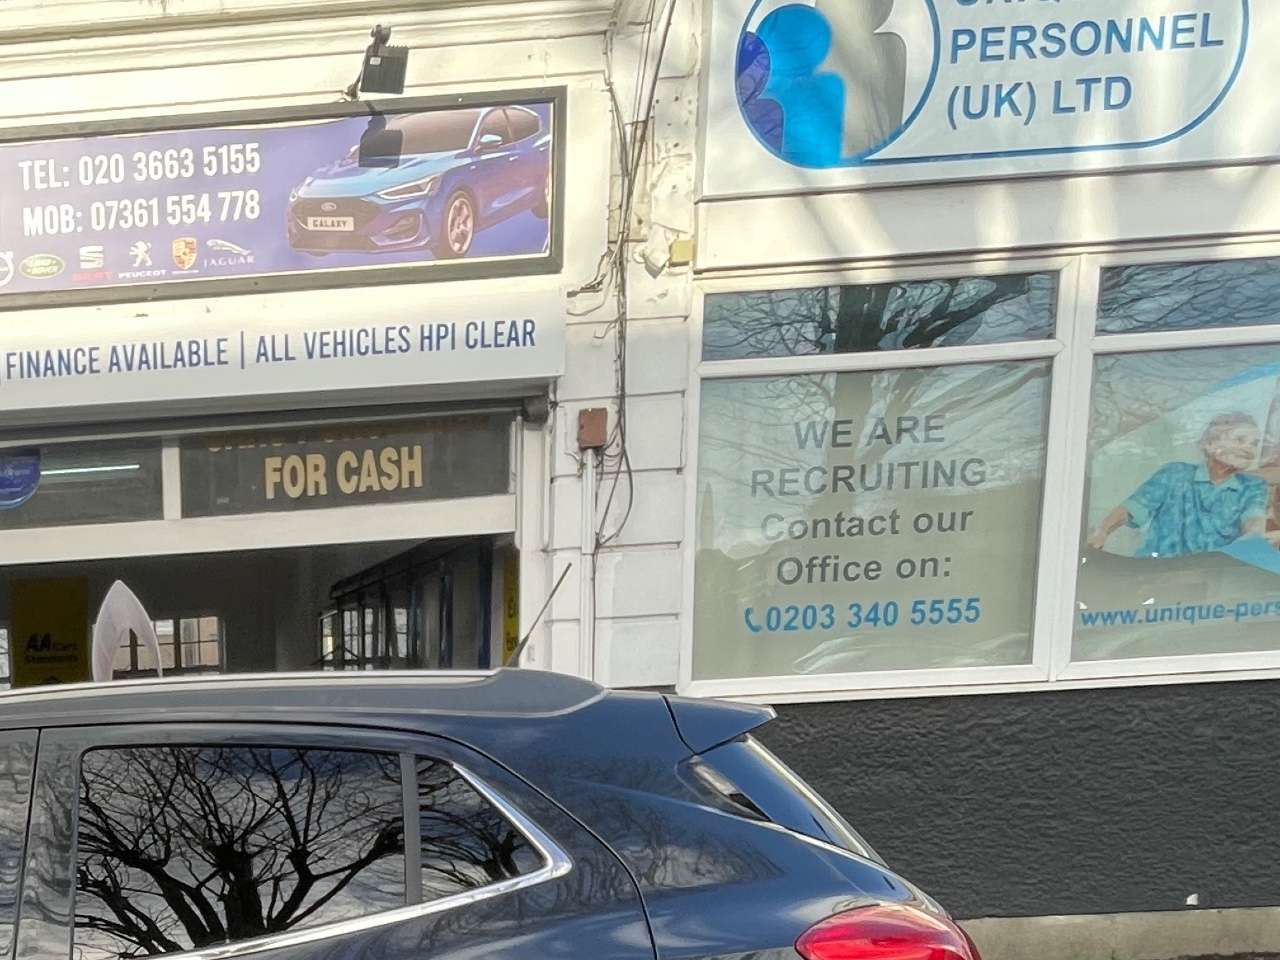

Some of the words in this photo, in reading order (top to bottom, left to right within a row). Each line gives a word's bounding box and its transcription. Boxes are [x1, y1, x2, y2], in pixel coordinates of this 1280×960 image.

[950, 13, 1224, 65] PERSONNEL
[947, 80, 1036, 130] (UK)
[1052, 76, 1132, 115] LTD
[18, 159, 70, 190] TEL:
[78, 152, 124, 186] 020
[132, 147, 195, 181] 3663
[202, 142, 261, 177] 5155
[22, 204, 84, 237] MOB:
[90, 197, 159, 231] 07361
[166, 193, 212, 225] 554
[217, 189, 260, 222] 778
[6, 346, 101, 380] FINANCE
[108, 337, 229, 374] AVAILABLE
[255, 333, 297, 364] ALL
[303, 325, 411, 360] VEHICLES
[419, 322, 456, 351] HPI
[464, 319, 536, 350] CLEAR
[794, 419, 854, 450] WE
[866, 414, 946, 447] ARE
[264, 454, 328, 500] FOR
[336, 445, 423, 495] CASH
[751, 457, 987, 499] RECRUITING
[760, 509, 902, 542] Contact
[912, 509, 975, 533] our
[776, 555, 883, 586] Office
[895, 556, 952, 579] on:
[765, 603, 836, 632] 0203
[847, 600, 899, 629] 340
[910, 597, 982, 626] 5555
